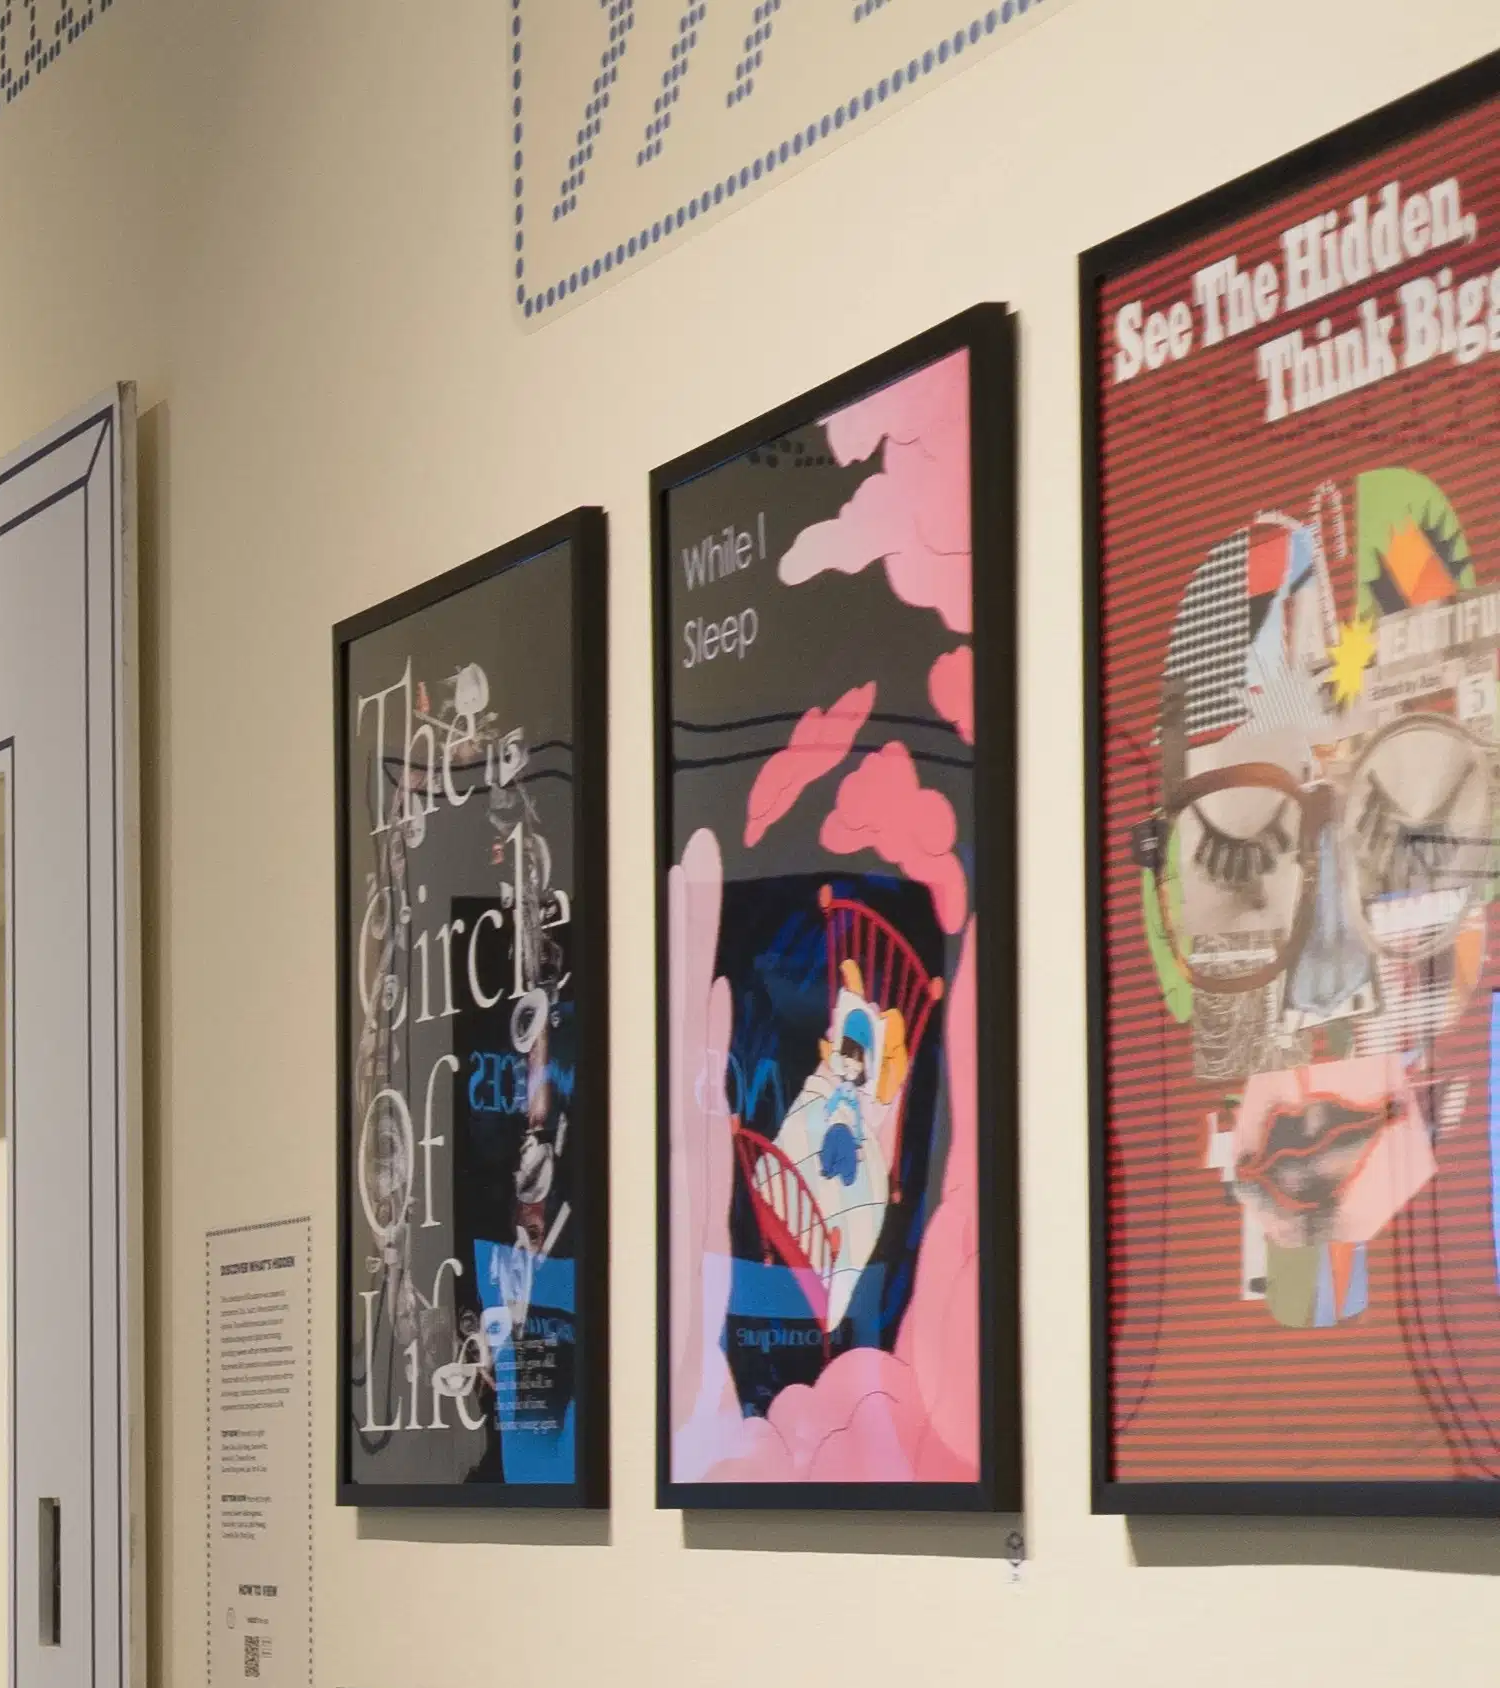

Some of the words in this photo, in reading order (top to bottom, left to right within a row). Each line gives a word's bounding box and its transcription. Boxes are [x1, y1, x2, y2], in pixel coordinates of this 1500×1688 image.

[1112, 300, 1193, 385] See
[1193, 255, 1279, 348] The
[1281, 177, 1478, 314] Hidden,
[1257, 298, 1397, 424] Think
[1397, 267, 1500, 368] Big
[682, 524, 752, 592] While
[757, 511, 767, 560] I
[683, 607, 759, 668] Sleep
[357, 655, 475, 835] The
[359, 822, 572, 1030] Circle
[358, 1055, 460, 1236] Of
[359, 1258, 488, 1432] Life
